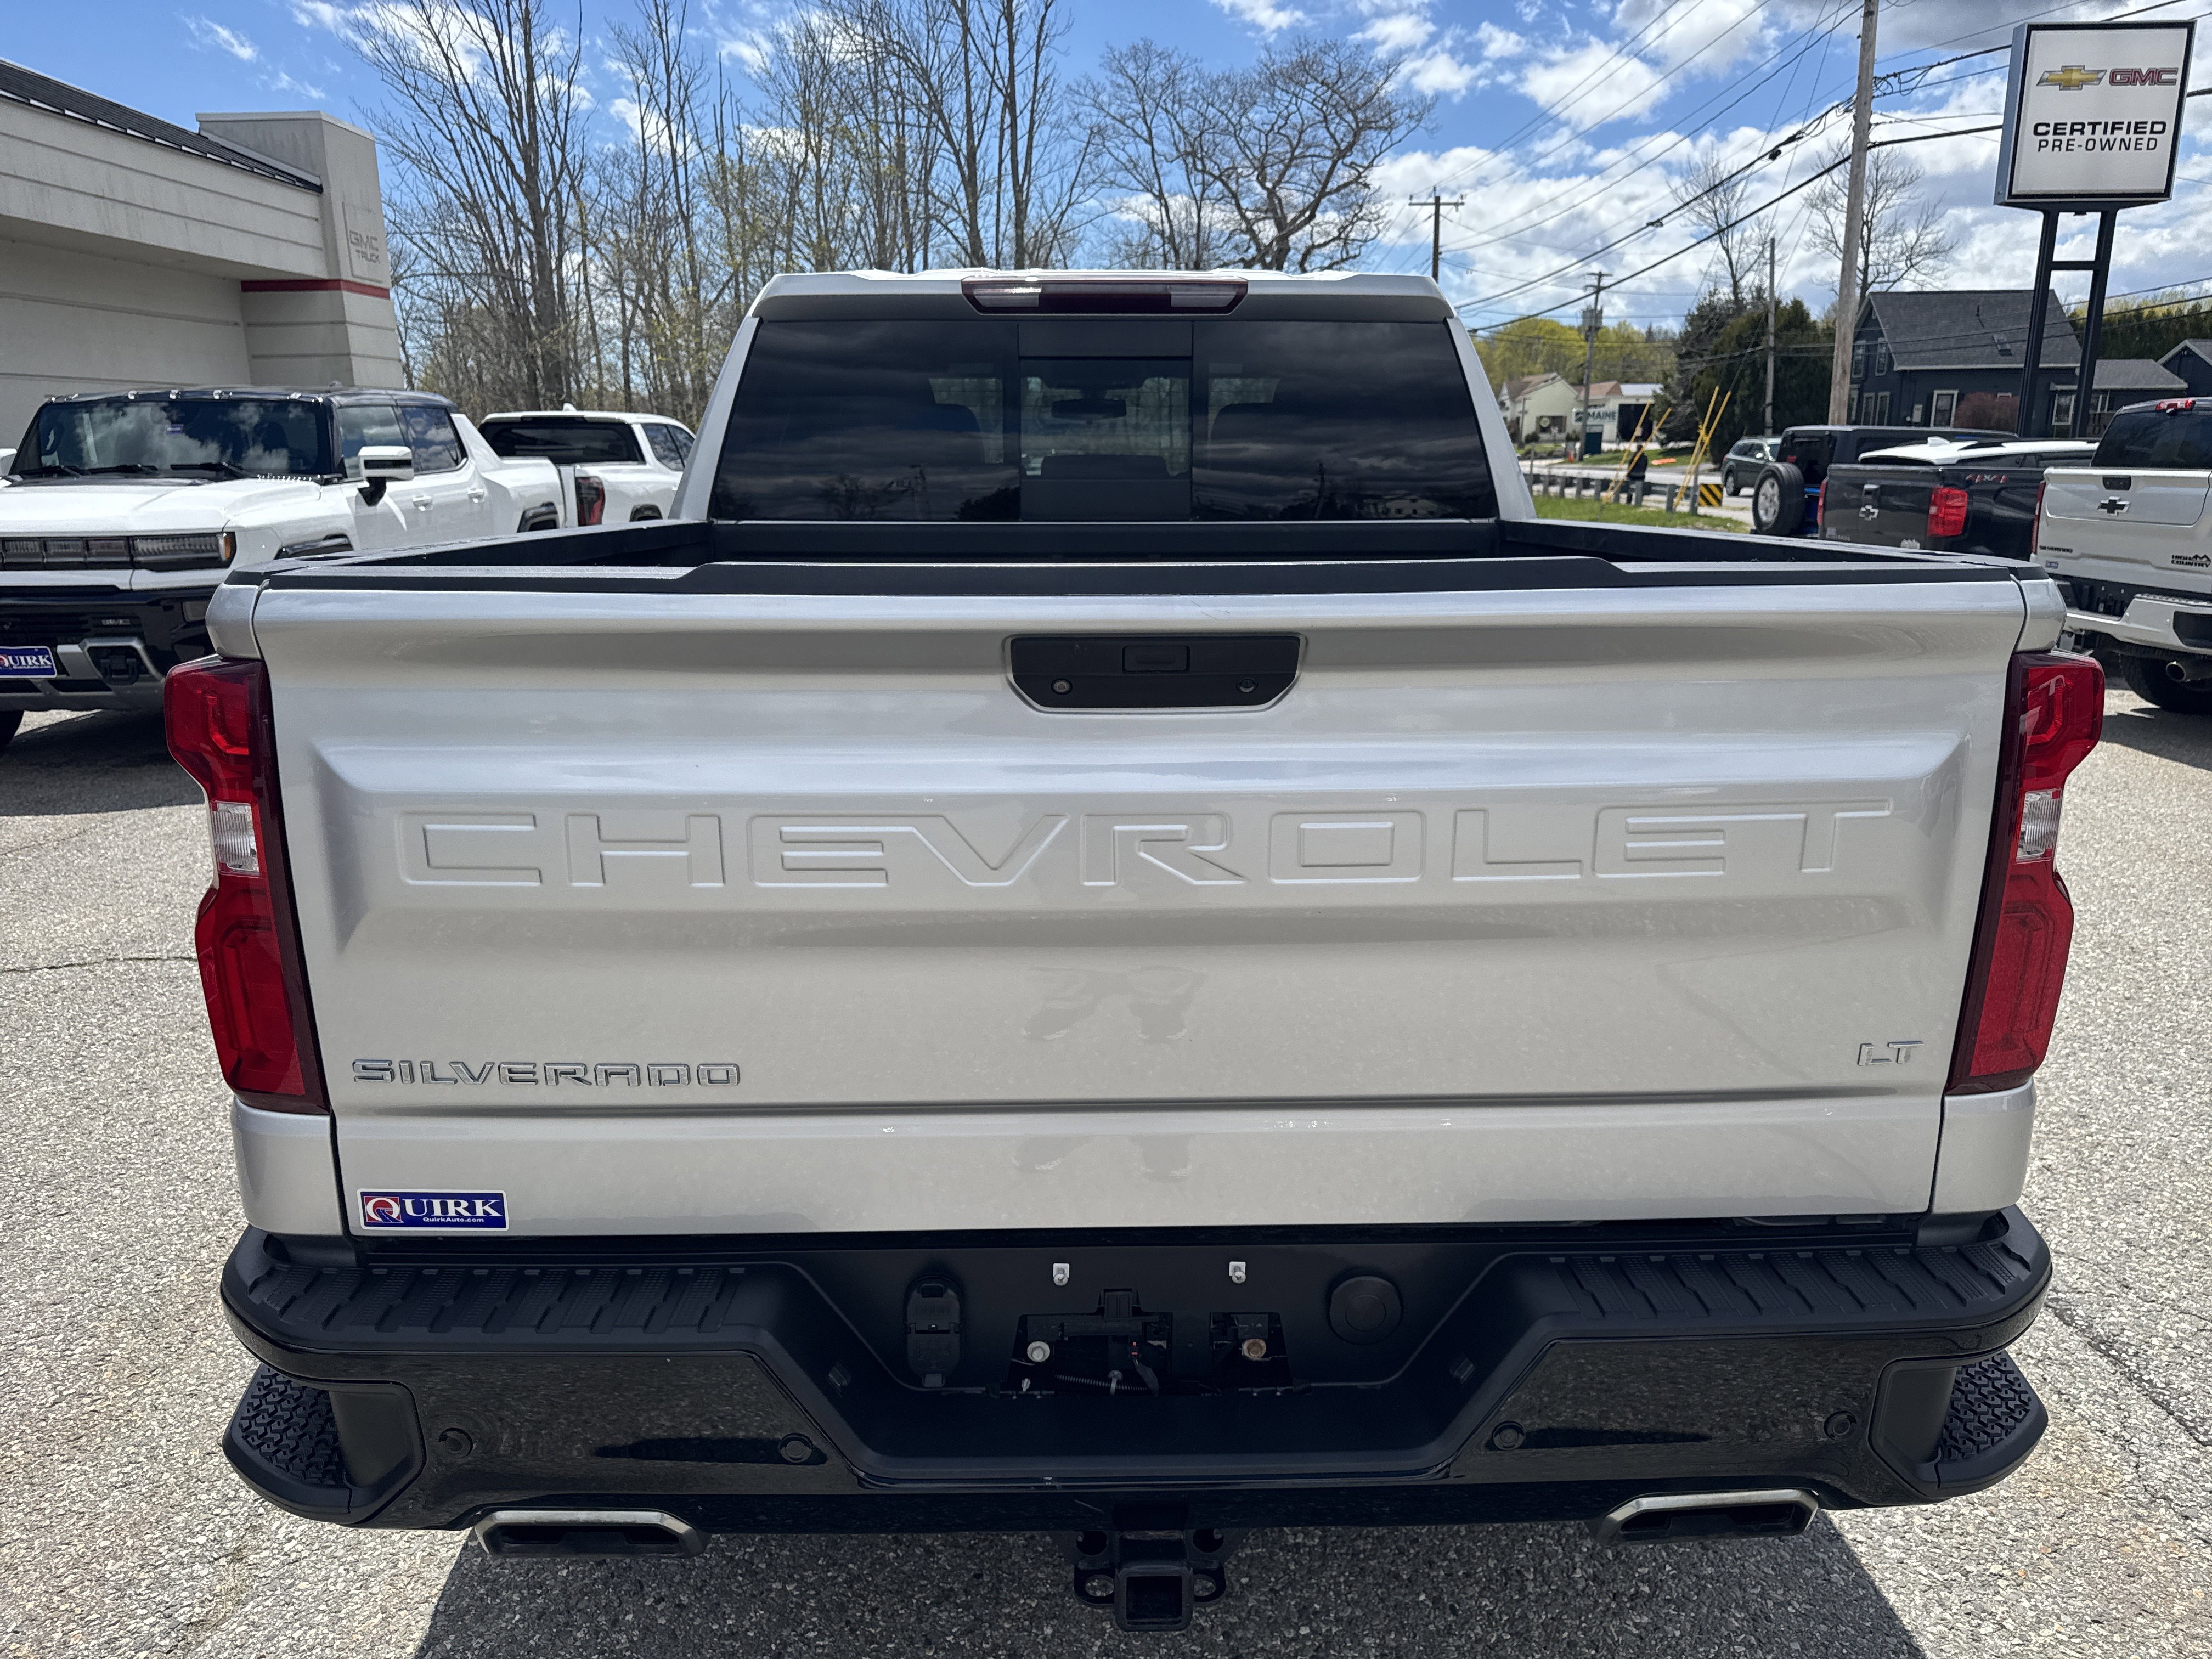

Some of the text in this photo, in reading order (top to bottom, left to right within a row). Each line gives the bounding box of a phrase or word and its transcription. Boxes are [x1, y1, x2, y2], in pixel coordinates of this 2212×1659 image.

[2109, 67, 2179, 86] GMC
[2033, 121, 2167, 136] CERTIFIED
[2038, 137, 2158, 153] PRE-OWNED
[349, 230, 379, 252] GMC
[395, 797, 1894, 887] CHEVROLET
[1857, 1040, 1925, 1066] LT
[352, 1059, 741, 1087] SILVERADO
[366, 1197, 504, 1223] QUIRK
